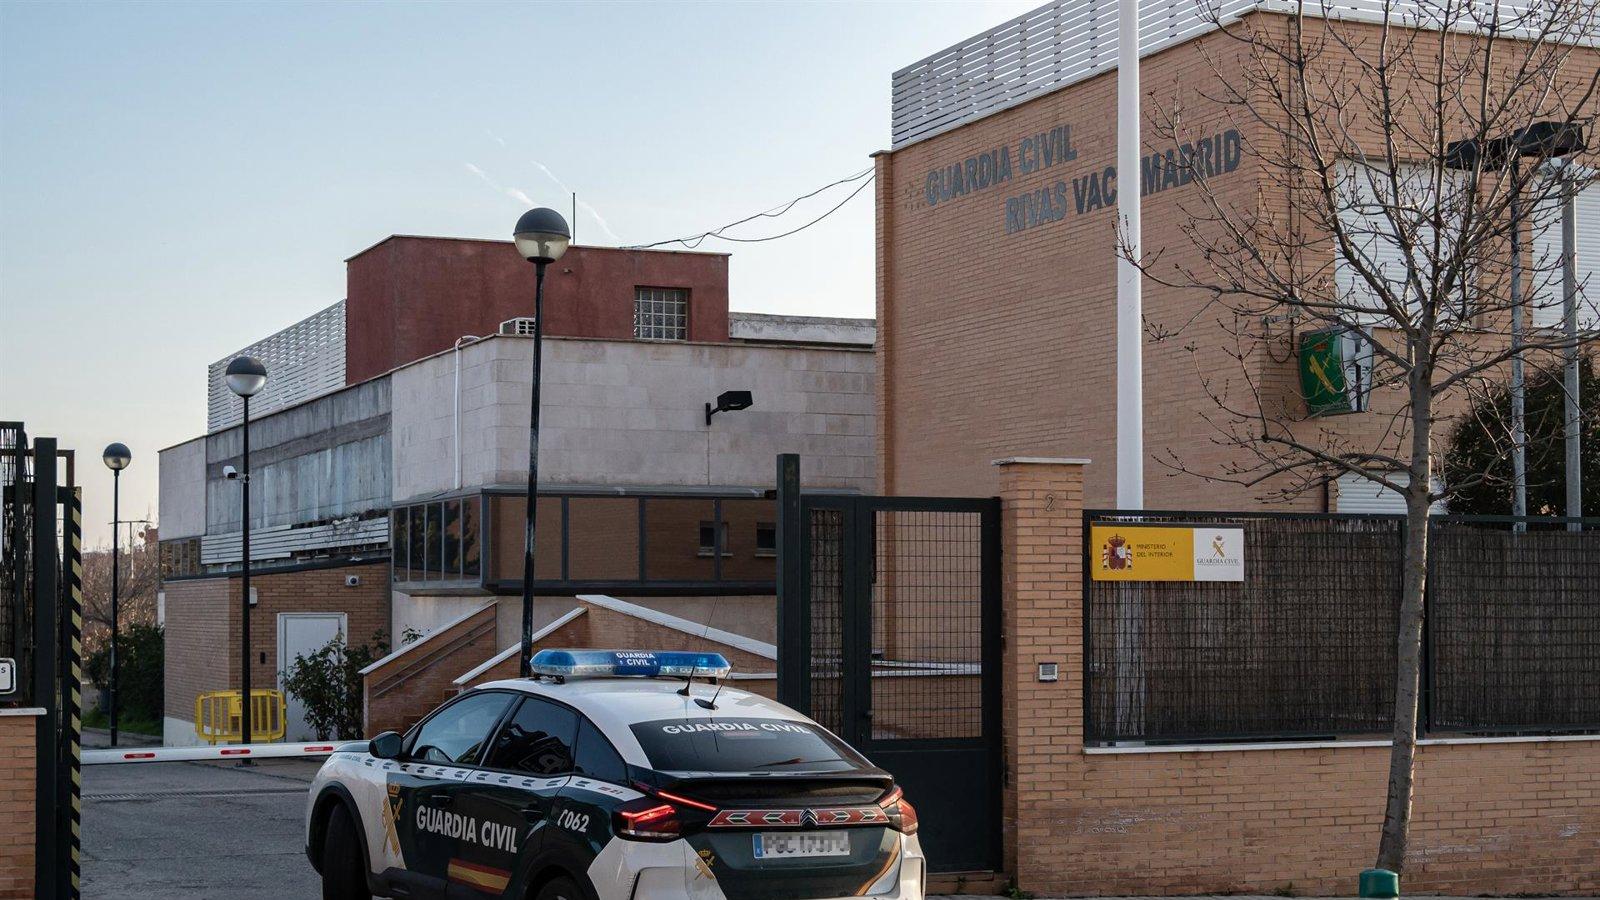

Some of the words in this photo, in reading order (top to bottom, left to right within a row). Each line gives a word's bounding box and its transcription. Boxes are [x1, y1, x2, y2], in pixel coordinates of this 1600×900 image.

[925, 145, 1013, 206] GUARDIA
[1019, 123, 1078, 175] CIVIL
[1005, 180, 1068, 235] RIVAS
[1072, 129, 1241, 215] VACMADRID
[1045, 494, 1056, 512] 2
[626, 658, 651, 666] CIVIL
[662, 722, 759, 735] GUARDIA
[760, 722, 812, 735] CIVIL
[416, 804, 477, 844] GUARDIA
[481, 820, 518, 854] CIVIL
